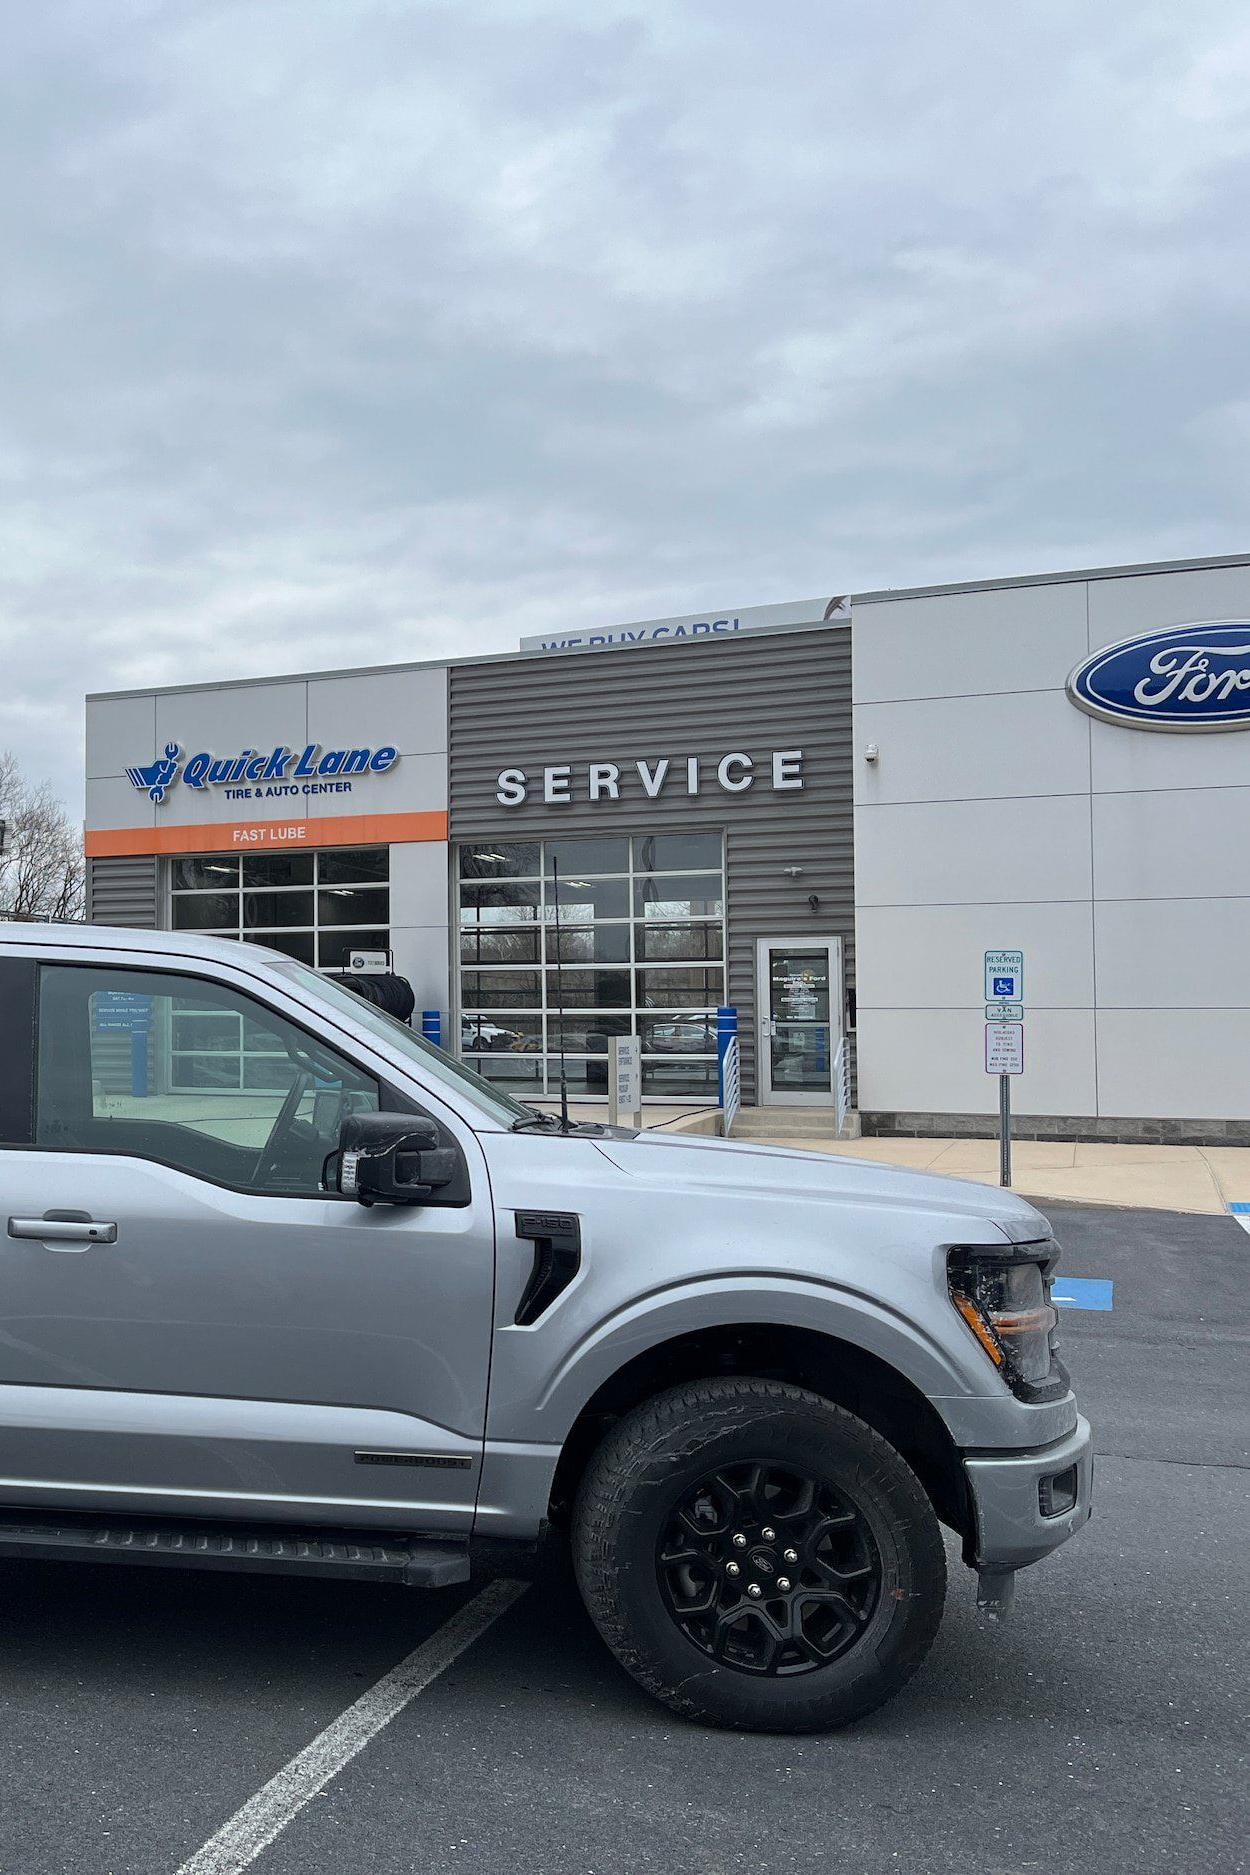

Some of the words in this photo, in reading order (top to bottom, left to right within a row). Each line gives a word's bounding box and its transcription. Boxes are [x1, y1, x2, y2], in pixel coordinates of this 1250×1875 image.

[1134, 645, 1250, 706] For
[182, 745, 295, 789] Quick
[292, 744, 400, 778] Lane
[495, 750, 805, 806] SERVICE
[224, 788, 252, 800] TIRE
[255, 788, 263, 798] &
[266, 785, 299, 797] AUTO
[302, 782, 352, 795] CENTER
[233, 829, 266, 842] FAST
[270, 827, 306, 840] LUBE
[986, 956, 1021, 964] RESERVED
[989, 966, 1019, 974] PARKING
